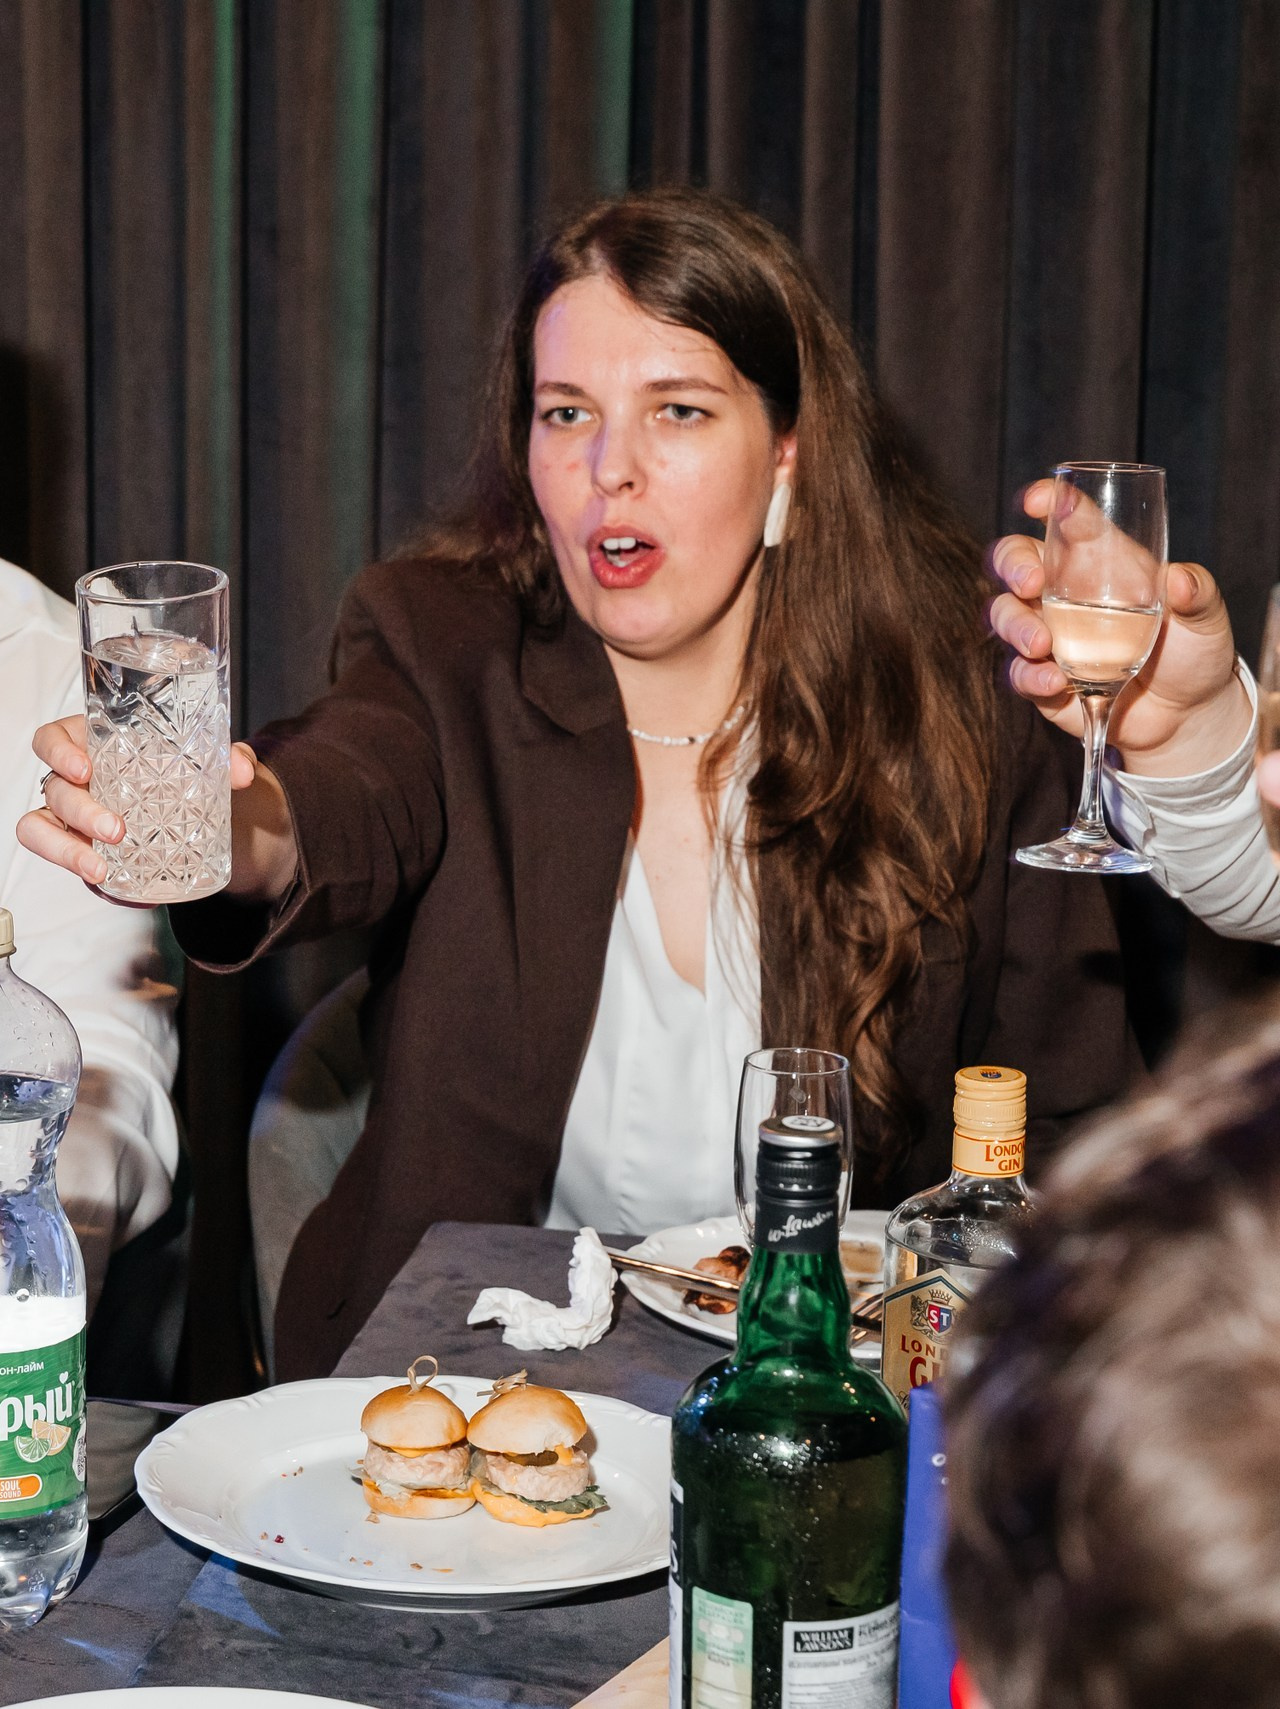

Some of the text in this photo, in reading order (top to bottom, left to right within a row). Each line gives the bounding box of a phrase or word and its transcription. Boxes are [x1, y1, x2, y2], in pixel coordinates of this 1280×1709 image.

[998, 1157, 1021, 1172] GIN
[0, 1480, 21, 1491] SOUL
[0, 1490, 22, 1499] SOUND
